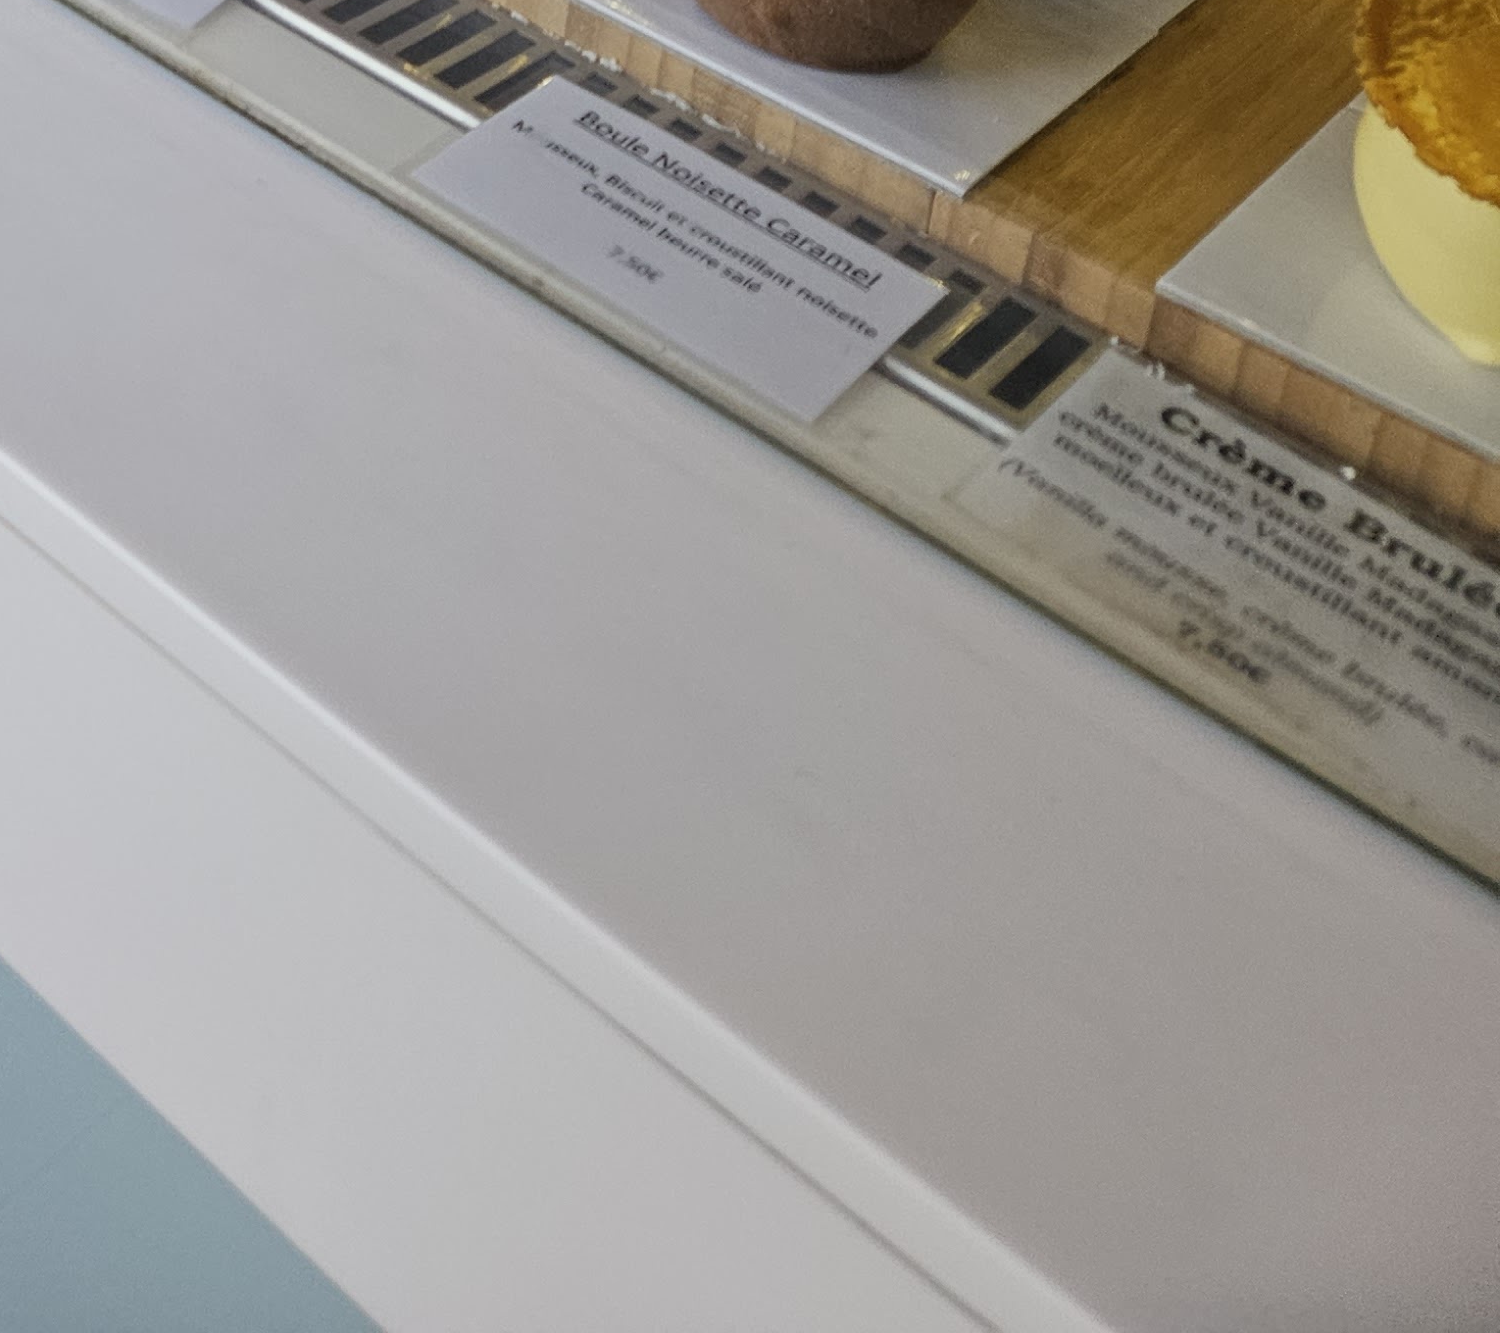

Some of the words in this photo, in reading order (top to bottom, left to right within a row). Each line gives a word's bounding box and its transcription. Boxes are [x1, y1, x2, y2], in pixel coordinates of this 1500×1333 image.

[512, 118, 600, 179] Msseux,
[604, 173, 666, 213] Biscuit
[666, 210, 688, 226] et
[688, 225, 796, 290] croustillant
[796, 286, 879, 339] noisette
[577, 109, 651, 159] Boule
[650, 150, 762, 221] Noisette
[766, 217, 884, 290] Caramel
[580, 182, 660, 231] Caramel
[655, 226, 721, 270] beurre
[720, 266, 763, 294] salé
[1160, 405, 1327, 514] Crème
[1342, 506, 1500, 623] Brulé
